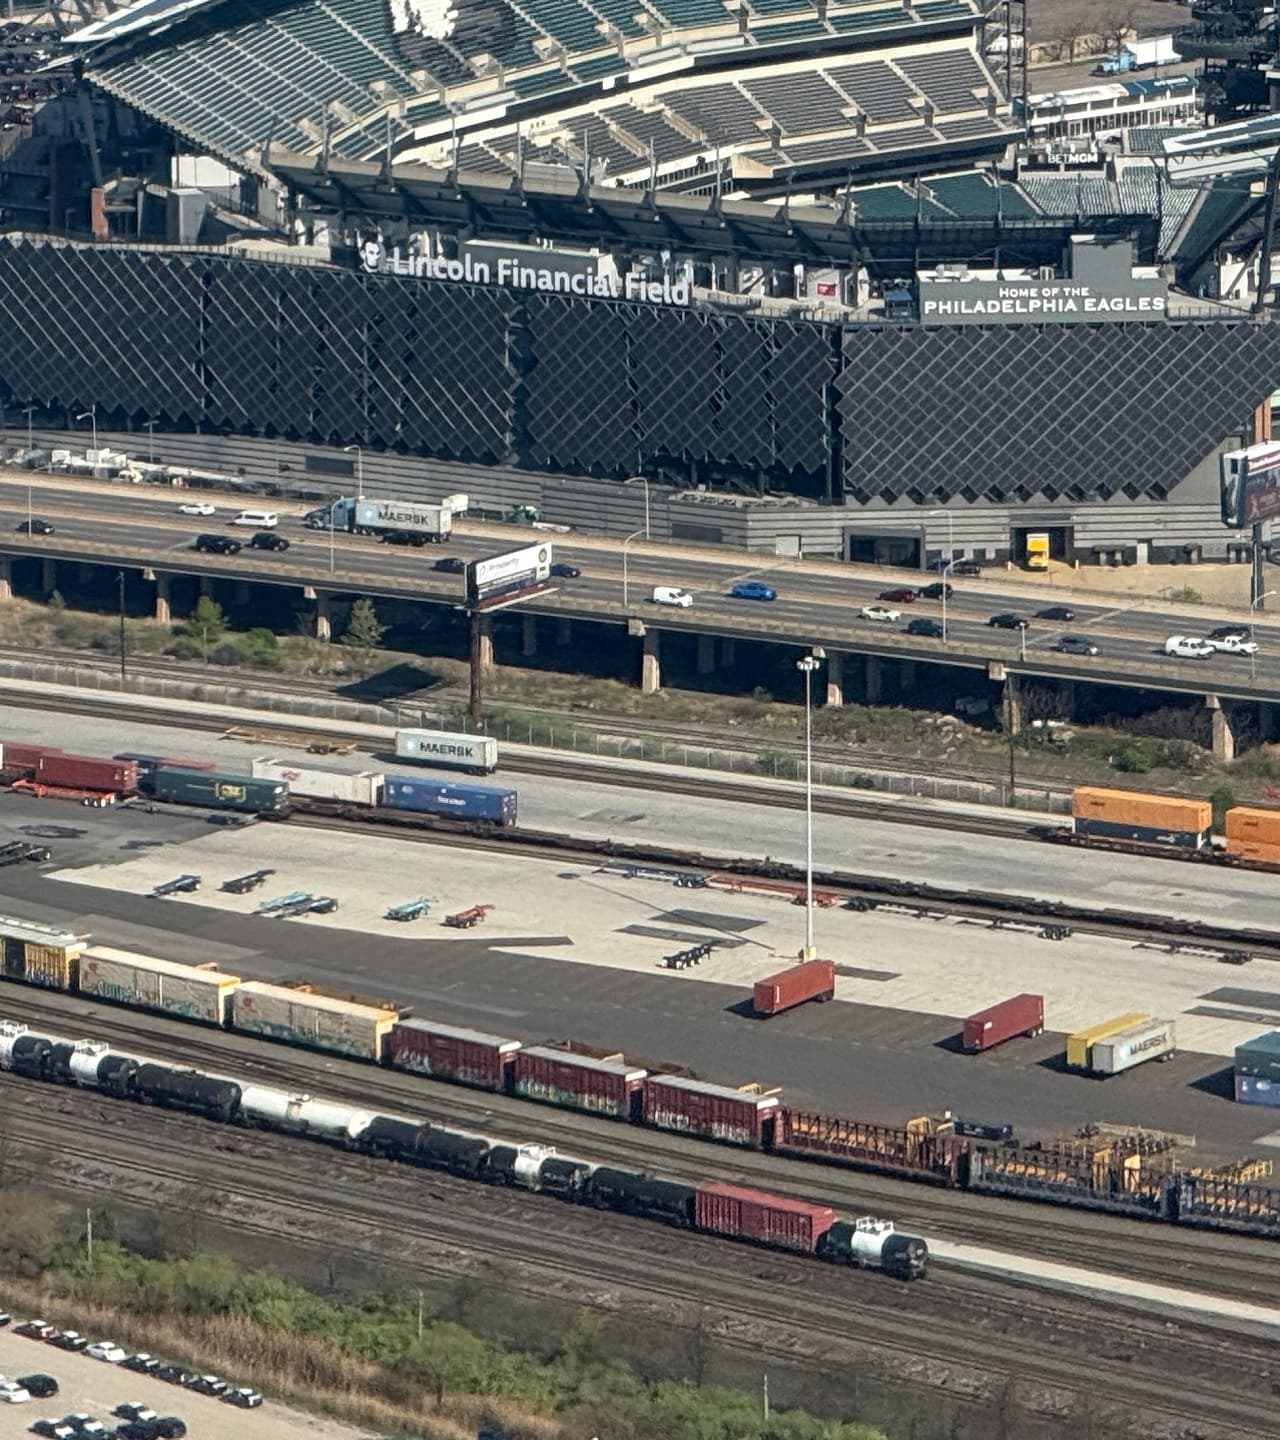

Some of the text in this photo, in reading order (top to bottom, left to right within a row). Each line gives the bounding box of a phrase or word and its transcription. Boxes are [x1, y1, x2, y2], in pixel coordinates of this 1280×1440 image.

[1047, 153, 1099, 165] BETMGM
[393, 246, 690, 306] Lincoln Financial Field
[999, 287, 1090, 298] HOME OF THE
[924, 296, 1165, 314] PHILADELPHIA EAGLES
[378, 510, 428, 526] MAERSK
[420, 742, 473, 758] MAERSK
[1129, 1031, 1168, 1055] MAERSK
